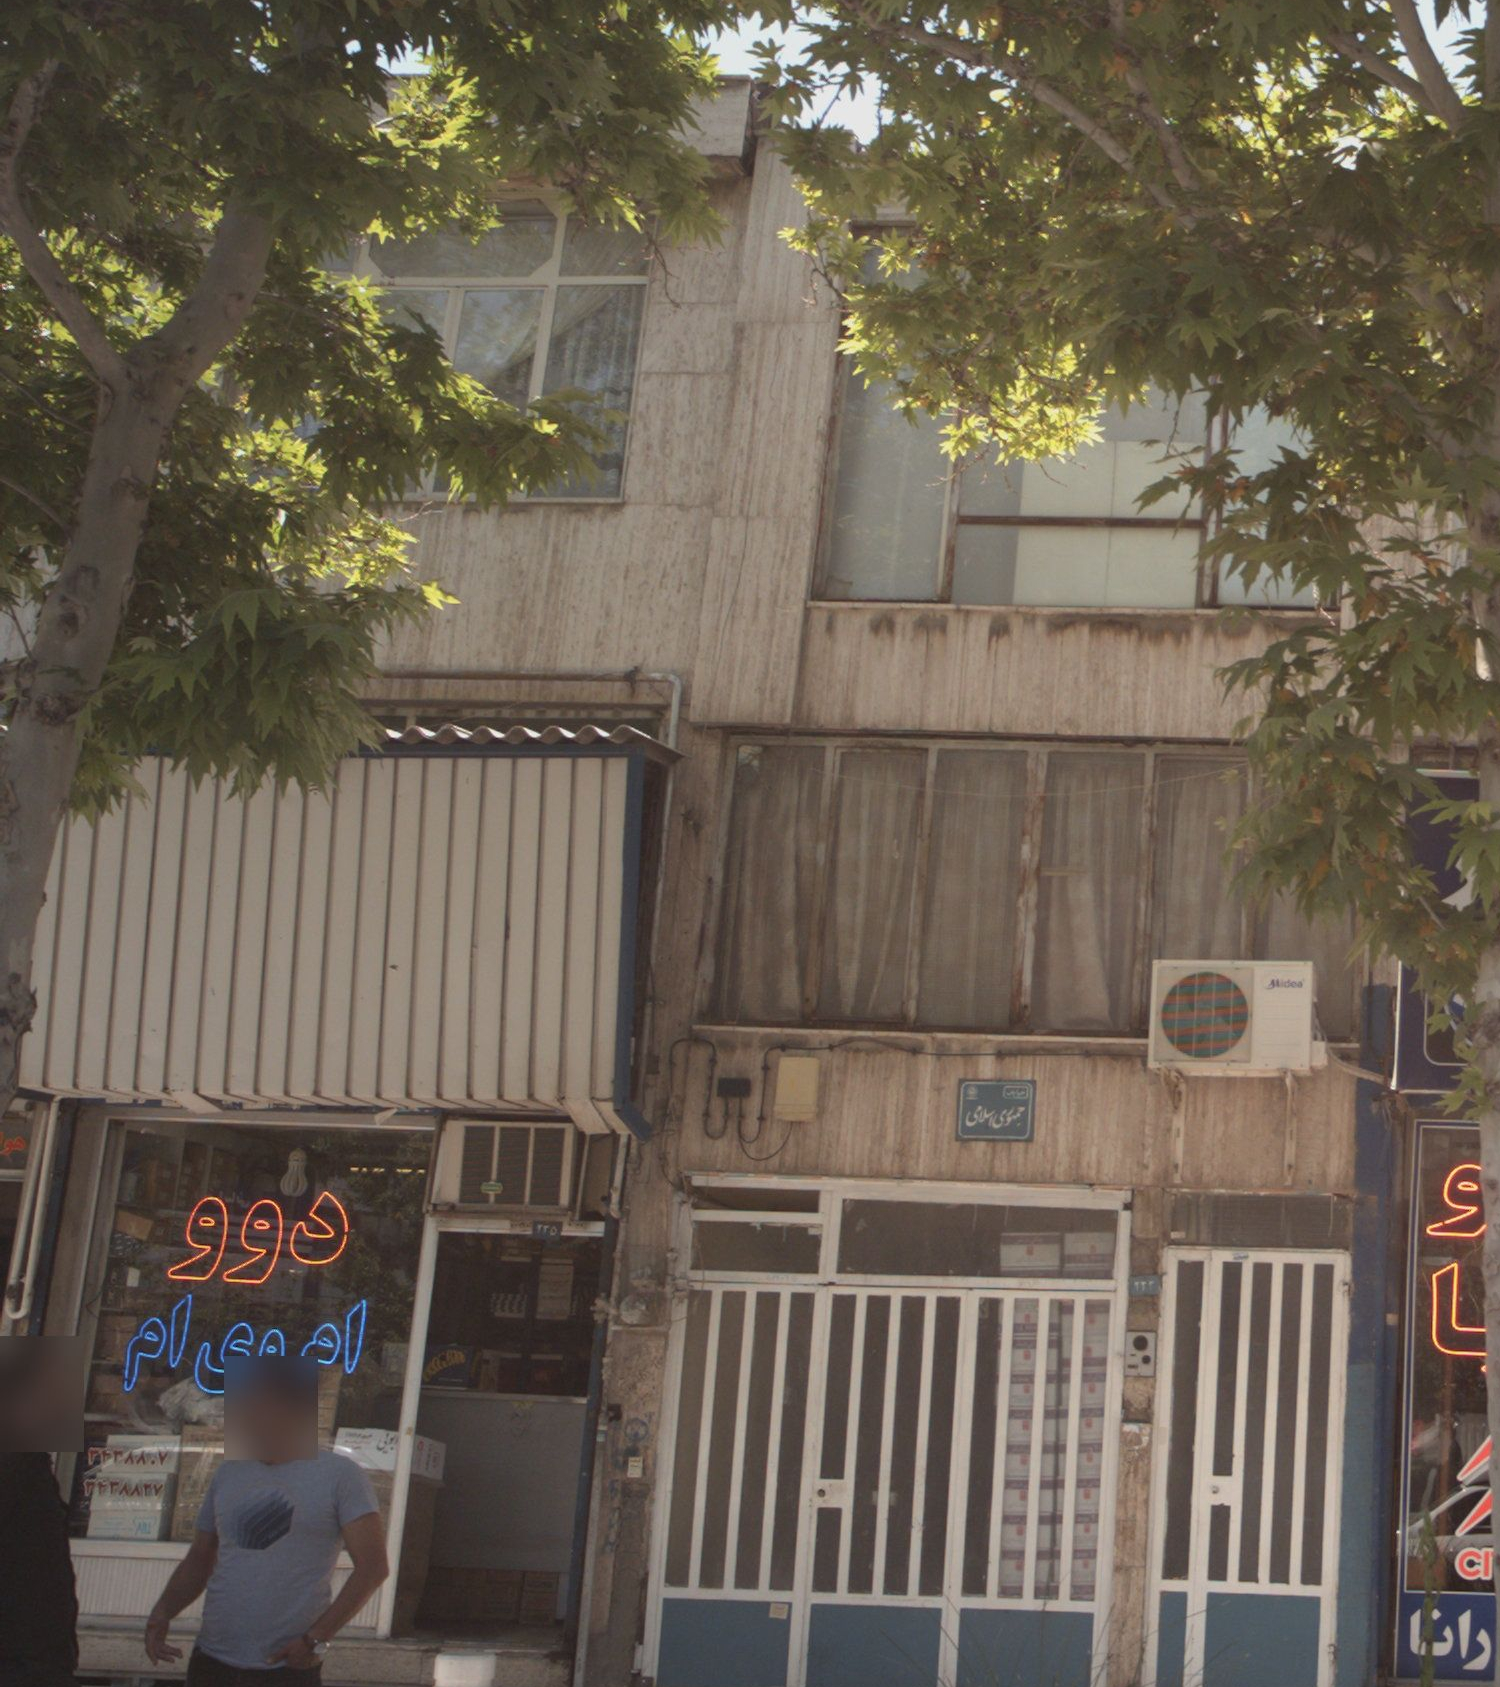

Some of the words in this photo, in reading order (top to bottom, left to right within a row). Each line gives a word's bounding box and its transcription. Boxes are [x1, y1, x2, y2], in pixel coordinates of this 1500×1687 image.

[1264, 978, 1305, 990] Midea
[167, 1190, 349, 1285] دوو
[123, 1293, 193, 1393] ام
[1409, 1608, 1492, 1671] رانا
